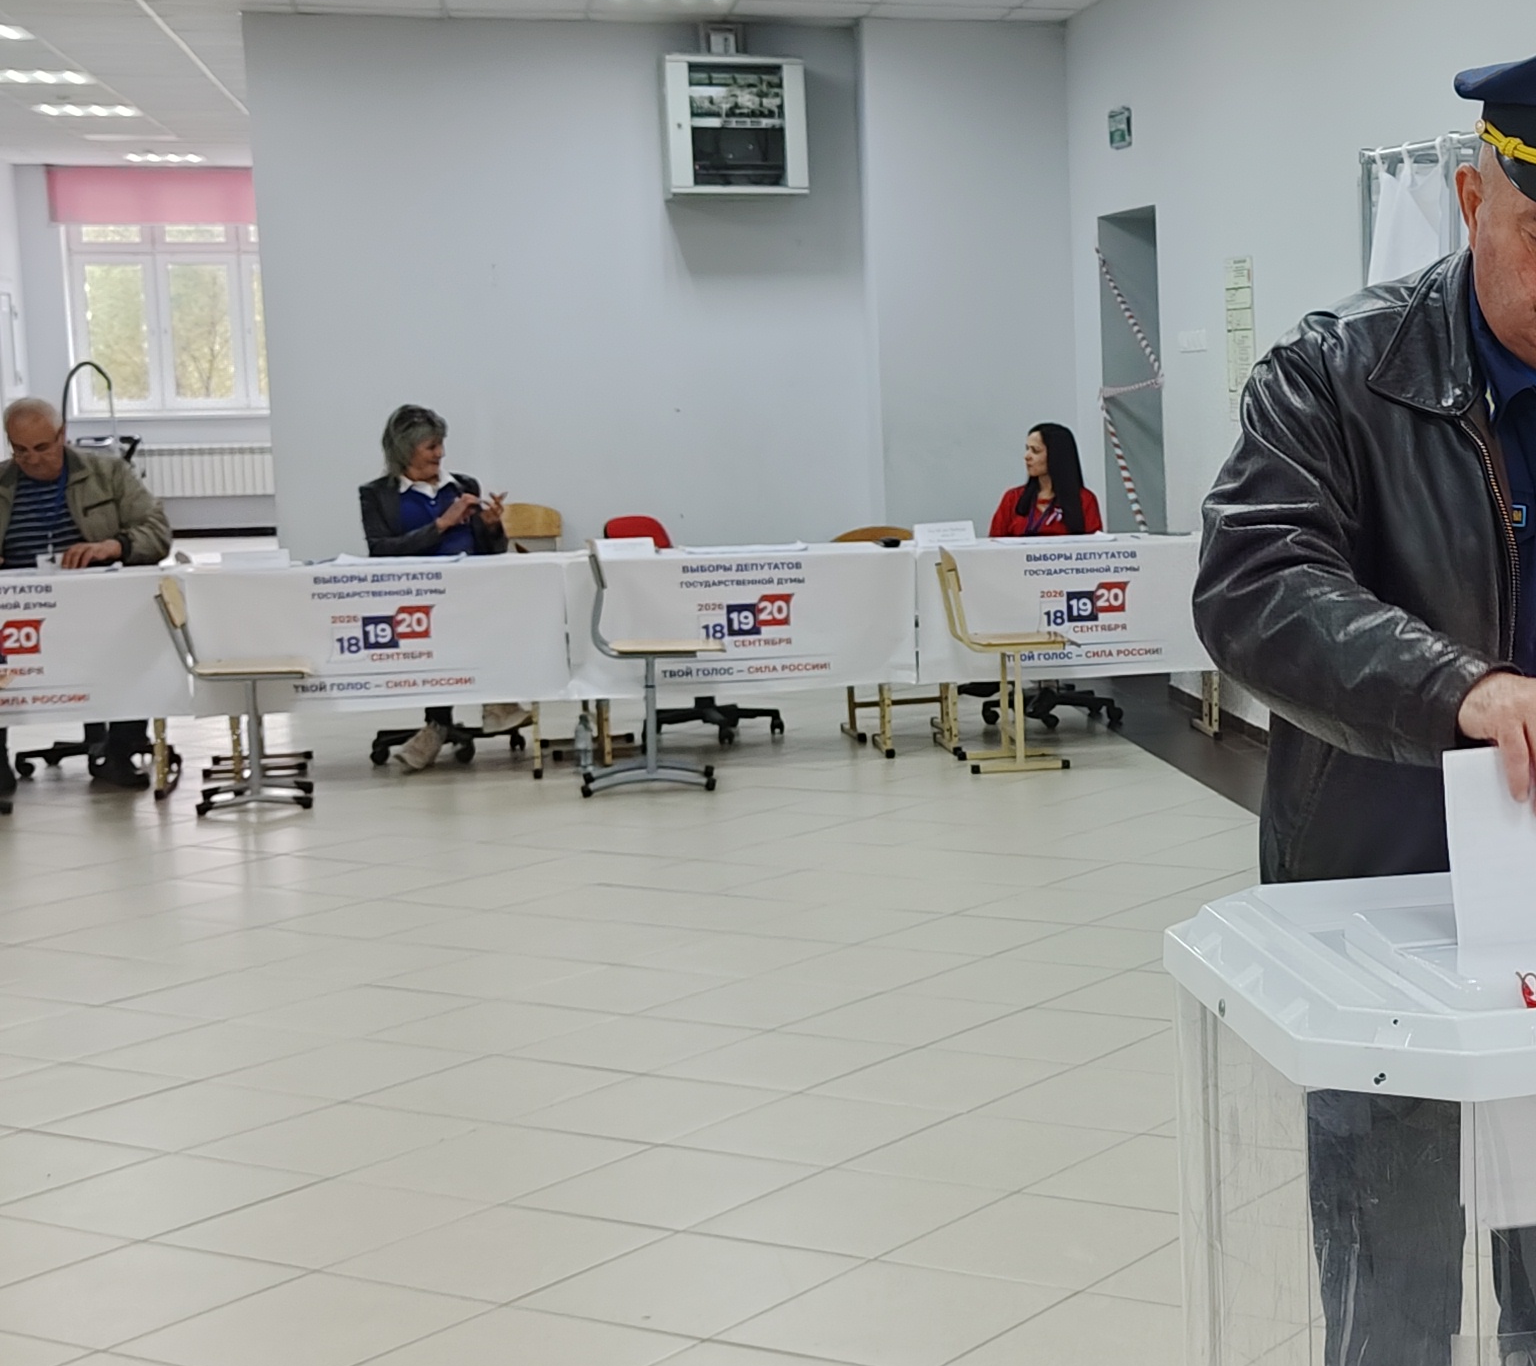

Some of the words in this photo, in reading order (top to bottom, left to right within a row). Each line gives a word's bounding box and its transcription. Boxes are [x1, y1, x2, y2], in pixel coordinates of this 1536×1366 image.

[1026, 553, 1072, 562] ВЫБОРЫ
[1075, 550, 1137, 561] ДЕПУТАТОВ
[682, 564, 732, 573] ВЫБОРЫ
[735, 561, 802, 572] ДЕПУТАТОВ
[1024, 567, 1111, 576] ГОСУДАРСТВЕННОЙ
[1113, 565, 1140, 574] ДУМЫ
[313, 575, 368, 584] ВЫБОРЫ
[371, 572, 442, 583] ДЕПУТАТОВ
[0, 584, 52, 595] УТАТОВ
[1040, 590, 1064, 598] 2026
[697, 603, 724, 611] 2026
[1043, 610, 1065, 626] 18
[1069, 597, 1092, 616] 19
[1096, 588, 1123, 606] 20
[331, 615, 360, 624] 2026
[701, 623, 725, 640] 18
[729, 611, 754, 630] 19
[758, 600, 787, 619] 20
[336, 636, 361, 655] 18
[365, 623, 392, 644] 19
[395, 612, 428, 633] 20
[1073, 623, 1127, 633] СЕНТЯБРЯ
[3, 626, 38, 649] 20
[734, 638, 792, 648] СЕНТЯБРЯ
[1006, 650, 1035, 662] ТОЙ
[1037, 652, 1073, 661] ГОЛОС
[1085, 650, 1113, 659] СИЛА
[1116, 647, 1163, 657] РОССИИ!
[662, 666, 693, 678] ТВОЙ
[696, 667, 734, 676] ГОЛОС
[747, 664, 778, 674] СИЛА
[329, 682, 371, 692] ГОЛОС
[385, 679, 418, 689] СИЛА
